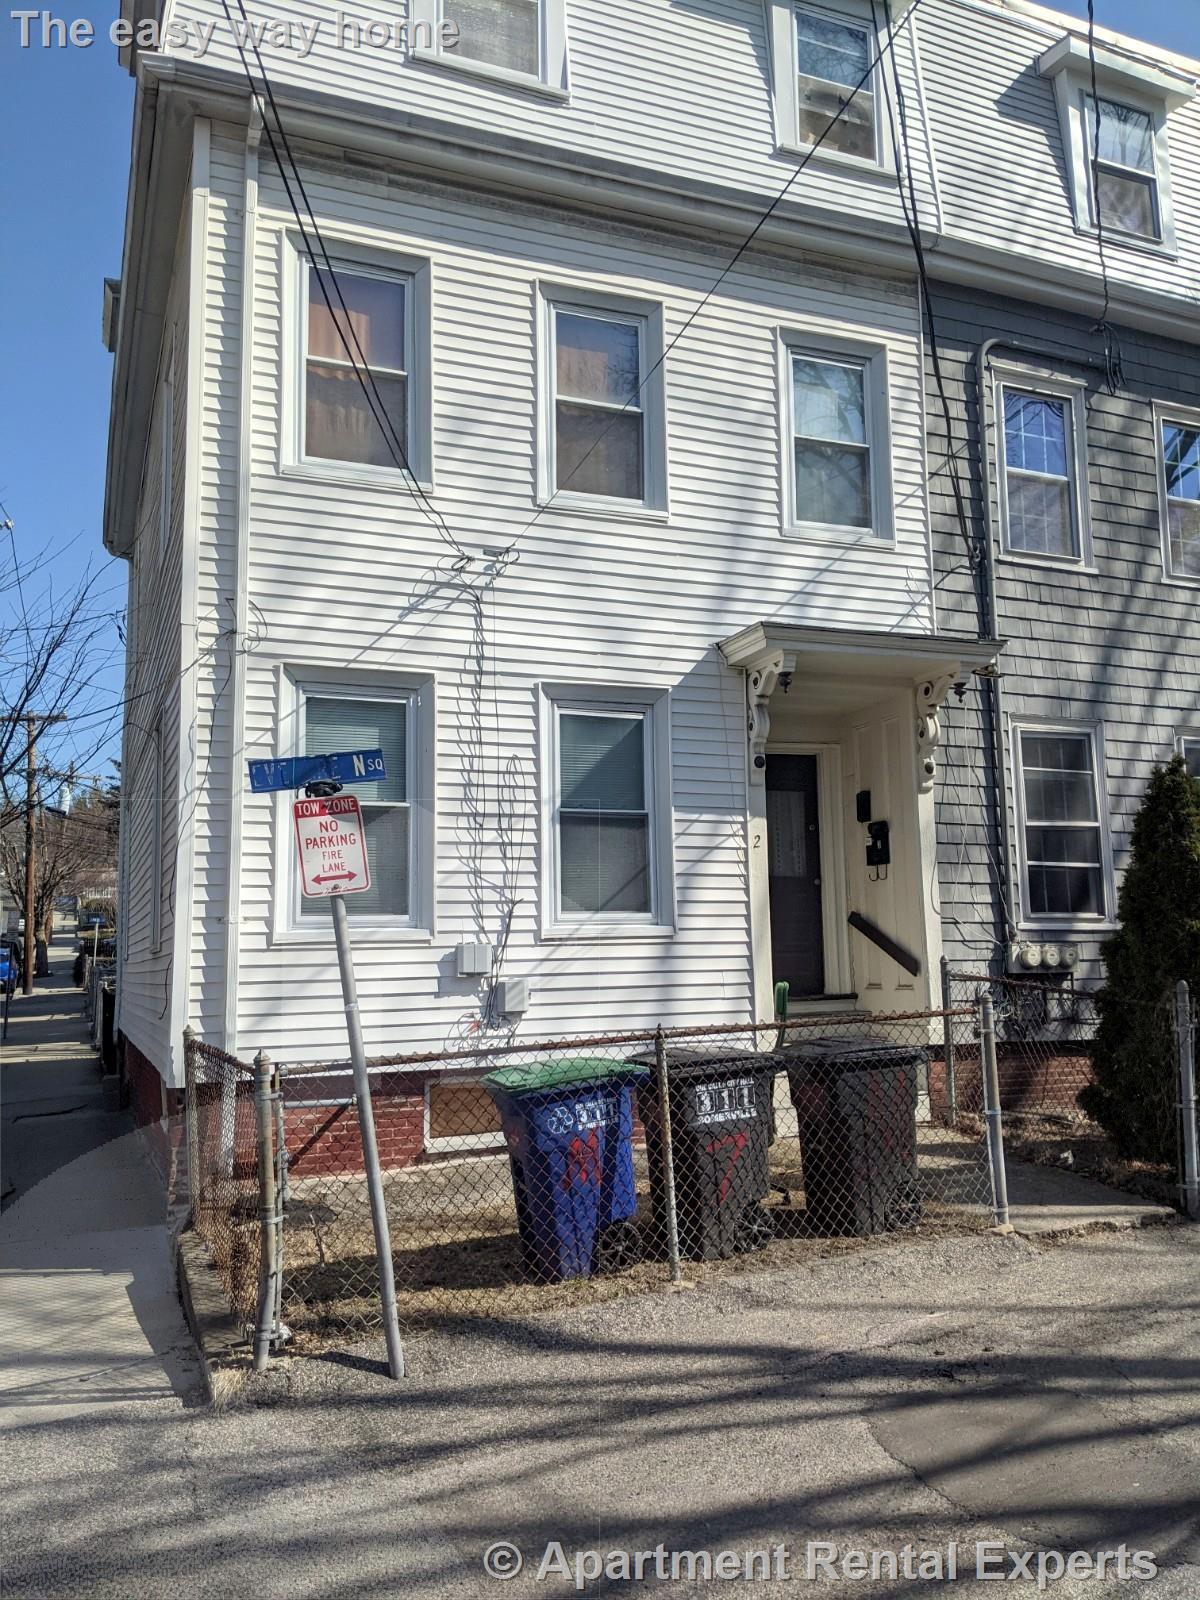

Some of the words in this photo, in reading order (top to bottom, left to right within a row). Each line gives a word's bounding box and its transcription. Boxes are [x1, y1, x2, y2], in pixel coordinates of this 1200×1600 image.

[367, 759, 384, 771] SQ
[296, 802, 320, 816] TOW
[324, 798, 356, 813] ZONE
[319, 820, 339, 833] NO
[305, 832, 356, 850] PARKING
[753, 834, 761, 849] 2
[322, 849, 343, 860] FIRE
[322, 861, 347, 873] LANE
[700, 1087, 750, 1112] 311
